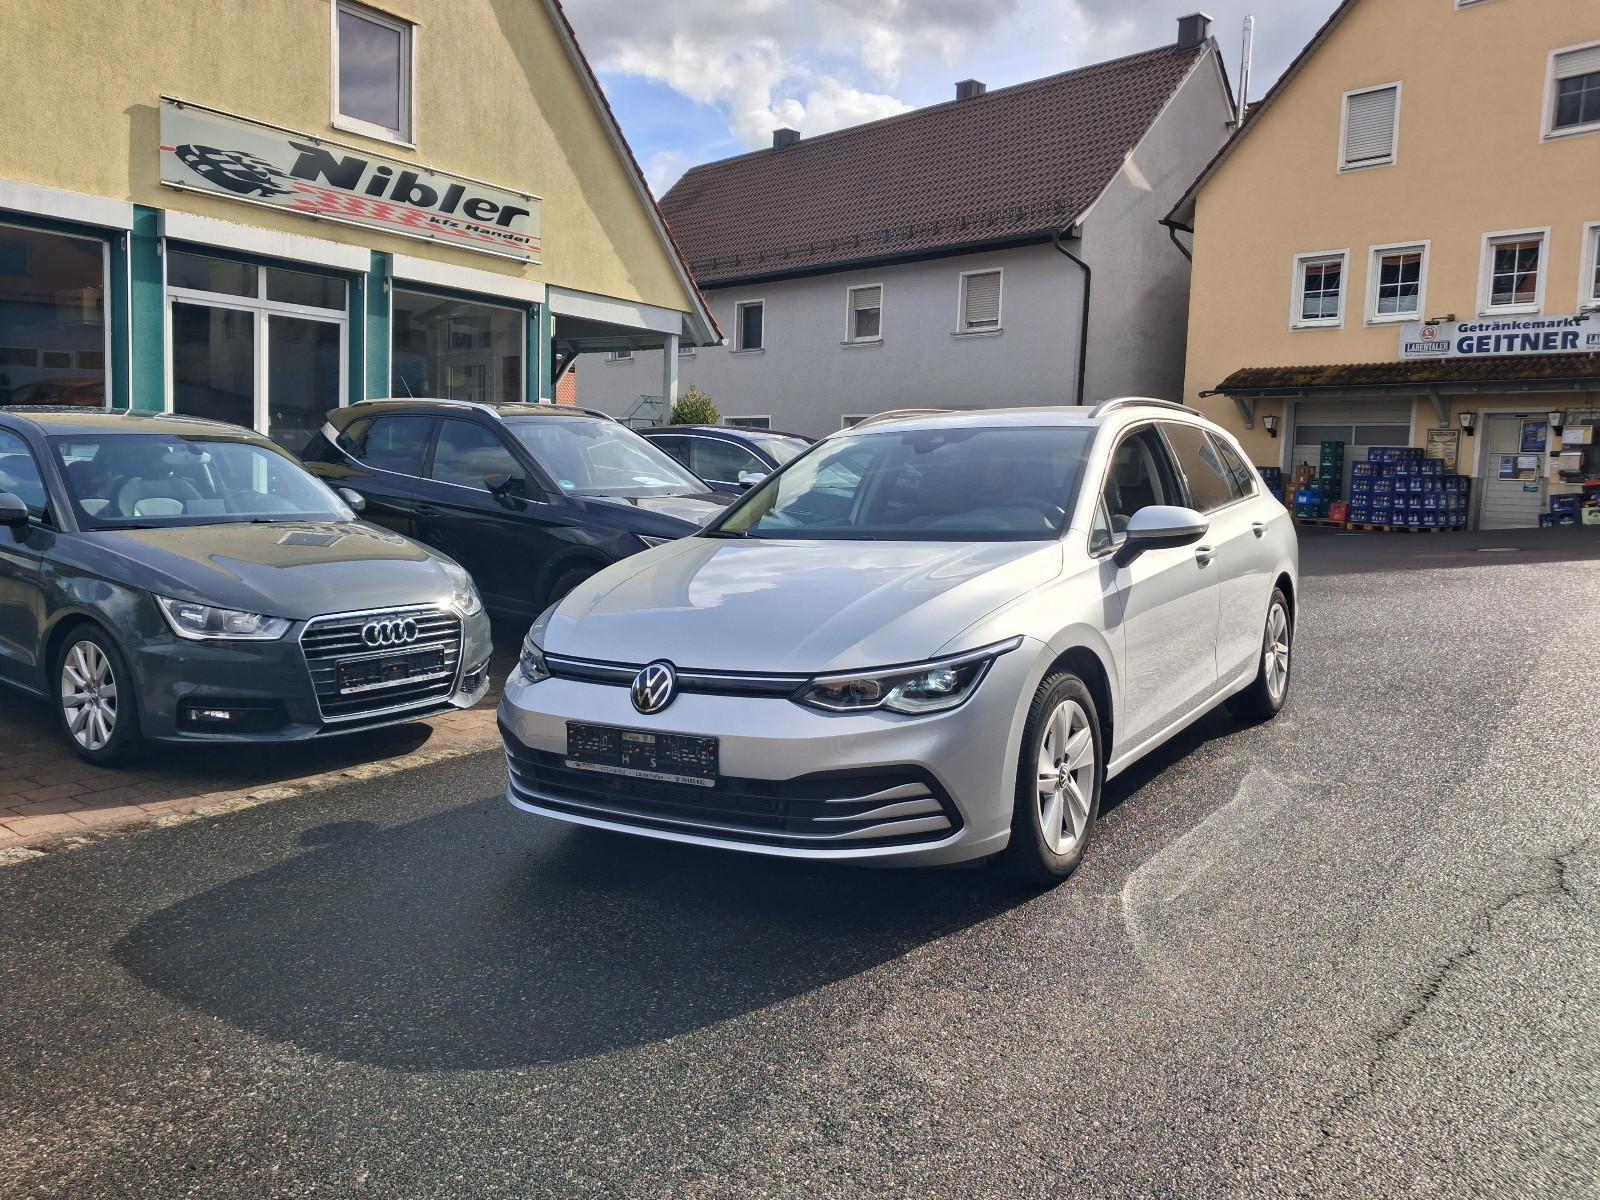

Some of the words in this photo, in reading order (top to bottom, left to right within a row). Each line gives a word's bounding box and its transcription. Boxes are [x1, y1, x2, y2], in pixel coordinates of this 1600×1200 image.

[288, 140, 530, 227] Nibler
[465, 224, 530, 244] Handel
[1457, 317, 1582, 333] Getränkemarkt
[1406, 341, 1449, 352] LABENTALER
[1456, 330, 1580, 354] GEITNER
[633, 664, 672, 710] VW
